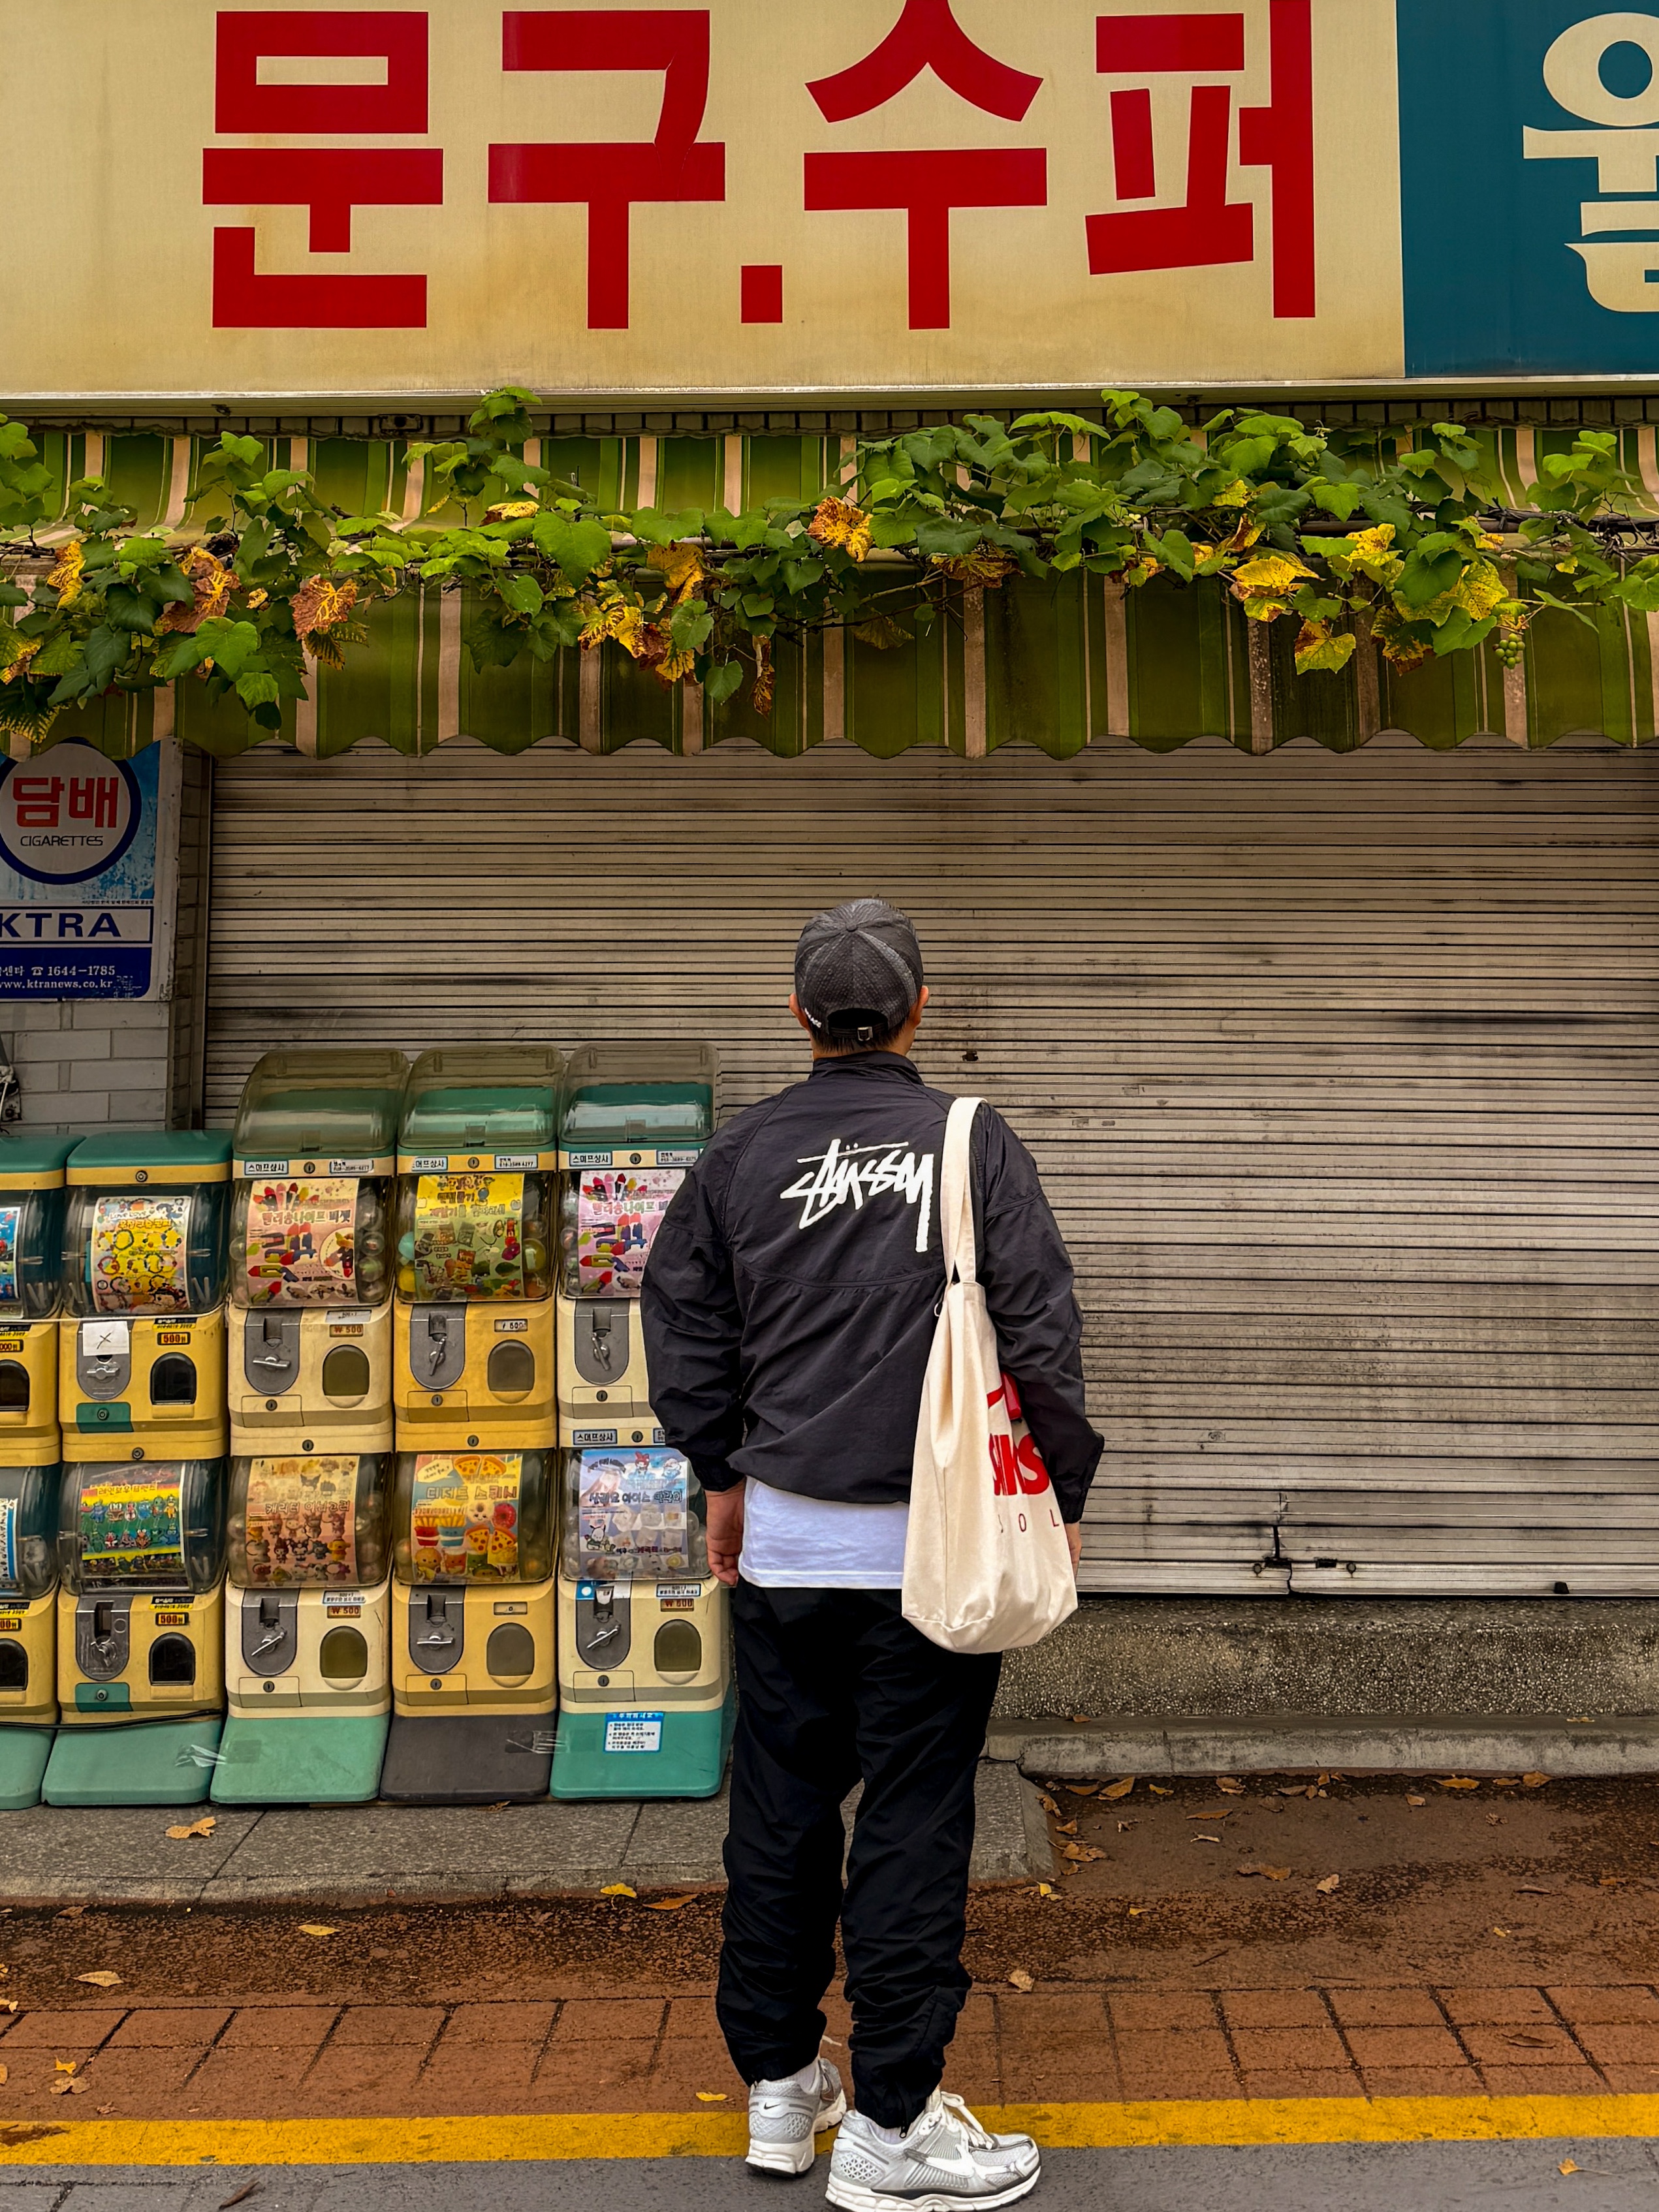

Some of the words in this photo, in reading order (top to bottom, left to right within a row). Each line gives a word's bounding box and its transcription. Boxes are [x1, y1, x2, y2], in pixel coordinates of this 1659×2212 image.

[12, 776, 119, 828] 담배
[20, 835, 103, 847] CIGARETTES
[0, 913, 122, 937] KTRA
[48, 966, 116, 976] 1644-1785
[412, 1158, 445, 1168] 머프상사
[163, 1334, 185, 1343] 500원
[426, 1486, 469, 1500] 디저트
[475, 1485, 517, 1500] 스퀴시
[622, 1491, 651, 1503] 아이스
[265, 1501, 300, 1514] 캐릭터
[161, 1615, 183, 1625] 500원
